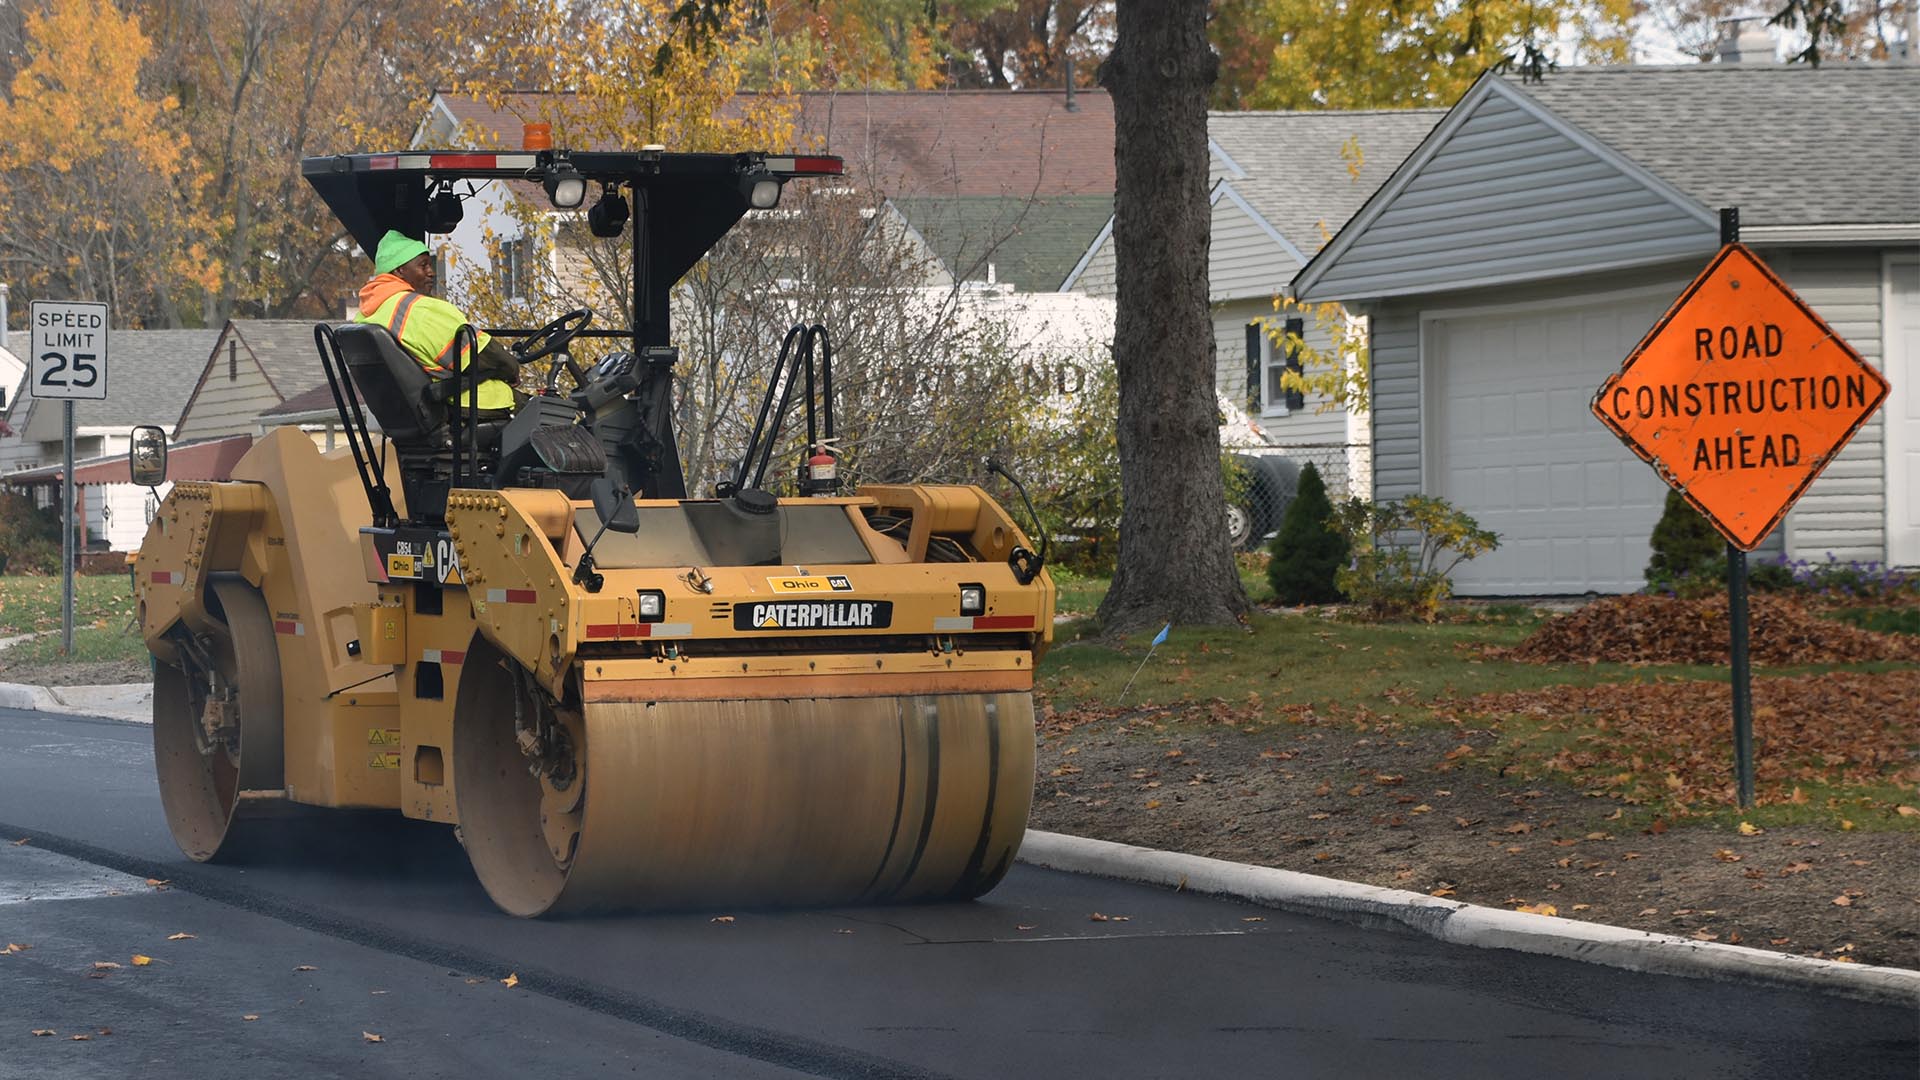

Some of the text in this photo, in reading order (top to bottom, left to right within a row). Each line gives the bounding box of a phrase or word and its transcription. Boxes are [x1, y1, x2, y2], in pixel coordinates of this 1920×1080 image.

[38, 312, 101, 328] SPEED
[45, 333, 94, 348] LIMIT
[1695, 324, 1783, 361] ROAD
[40, 352, 97, 387] 25
[1613, 374, 1865, 420] CONSTRUCTION
[1693, 434, 1800, 471] AHEAD
[393, 560, 409, 571] Ohio
[437, 540, 466, 584] CA
[782, 578, 848, 589] Ohio CAT
[753, 603, 873, 627] CATERPILLAR
